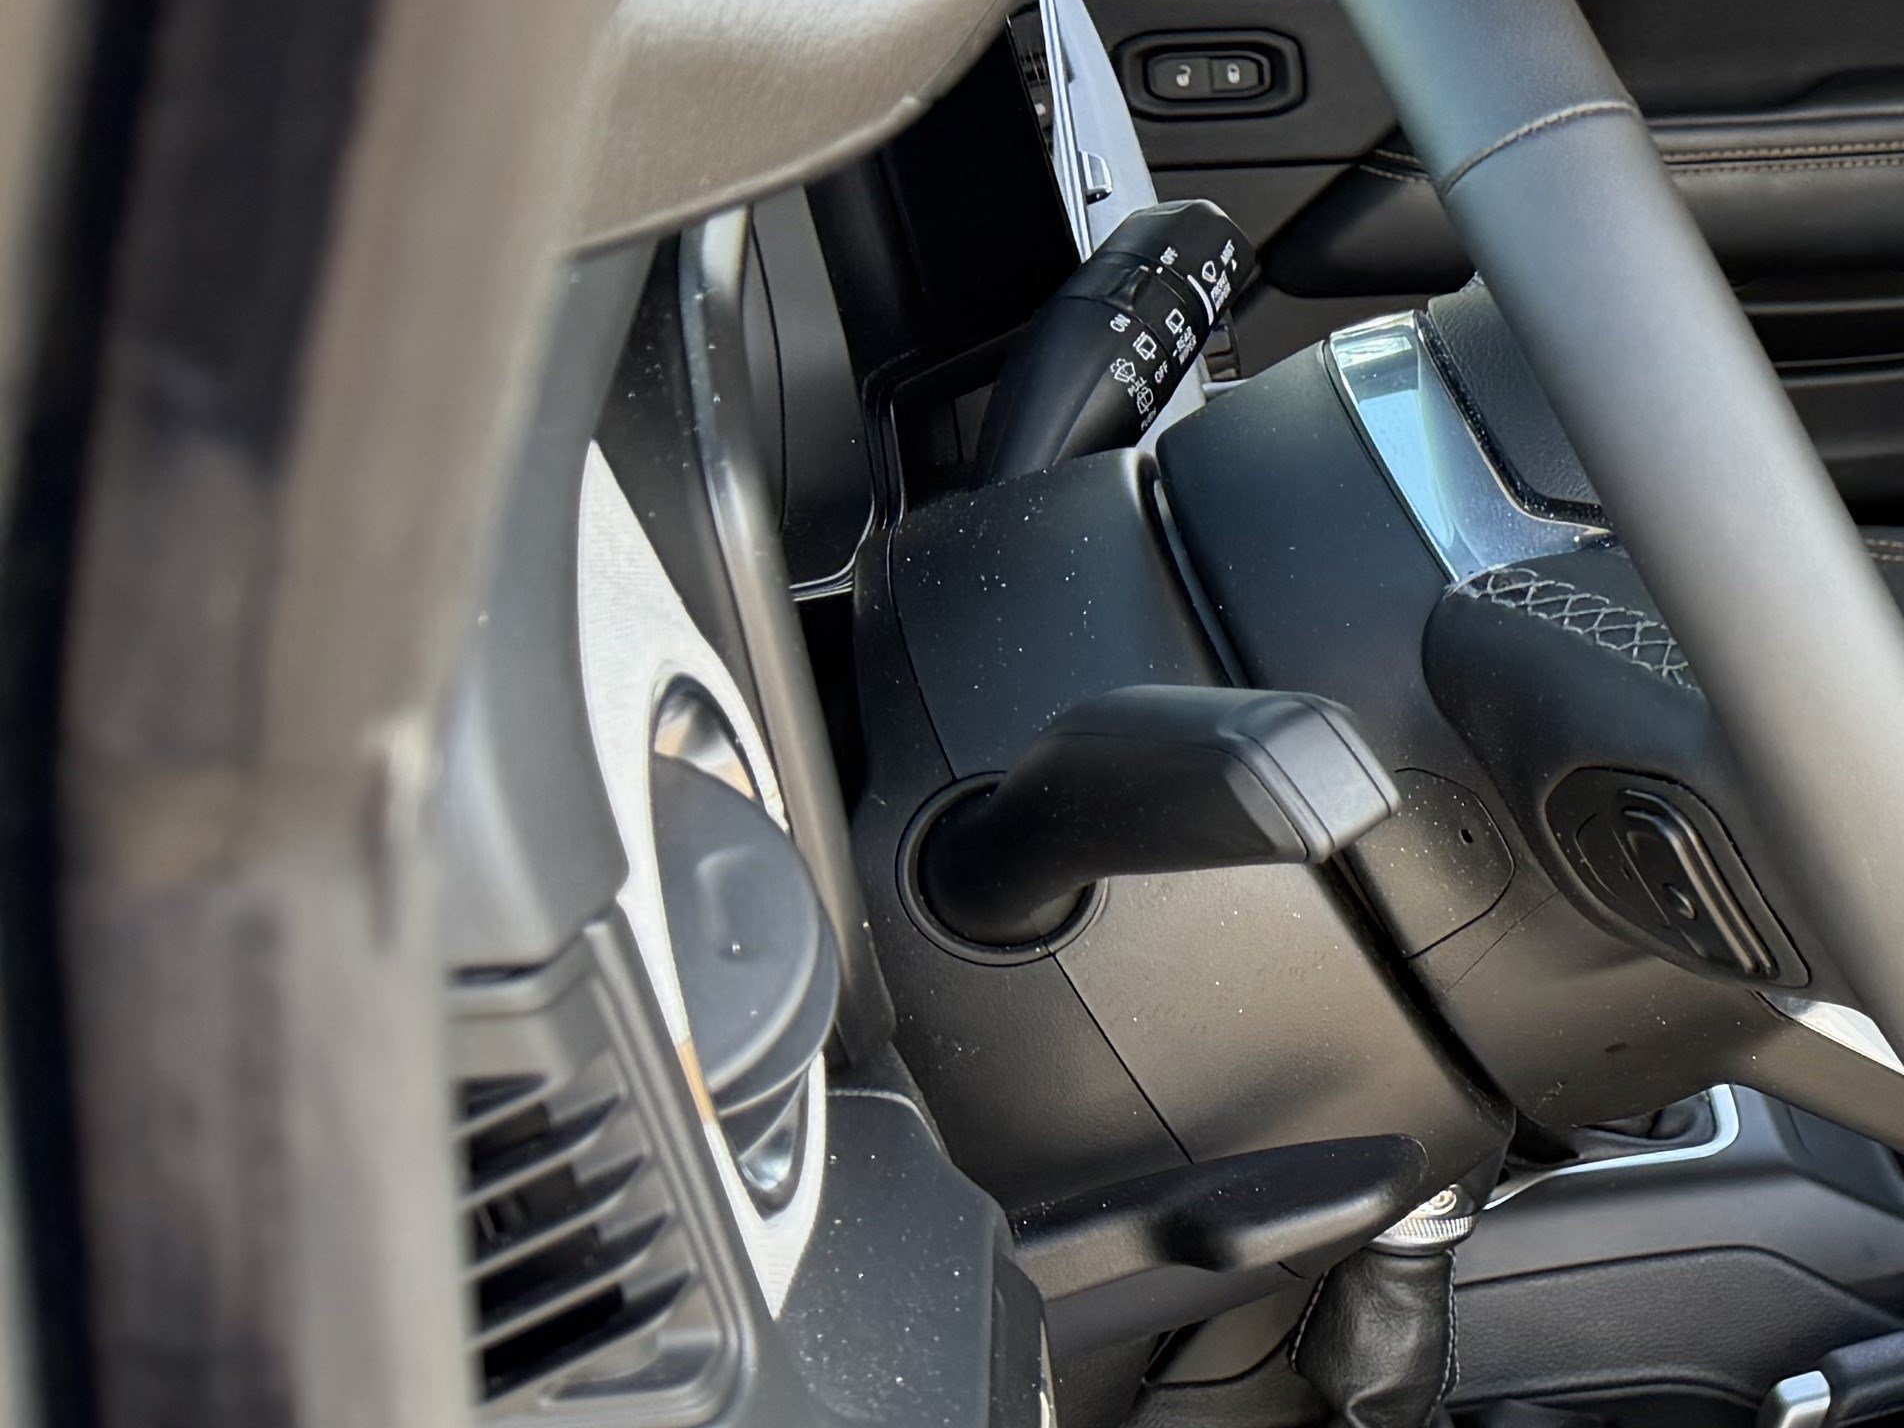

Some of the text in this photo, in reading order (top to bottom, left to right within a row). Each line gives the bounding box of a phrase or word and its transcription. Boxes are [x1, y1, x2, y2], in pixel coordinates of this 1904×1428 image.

[1110, 313, 1131, 332] ON
[1154, 360, 1168, 384] OFF
[1127, 376, 1147, 398] PULL
